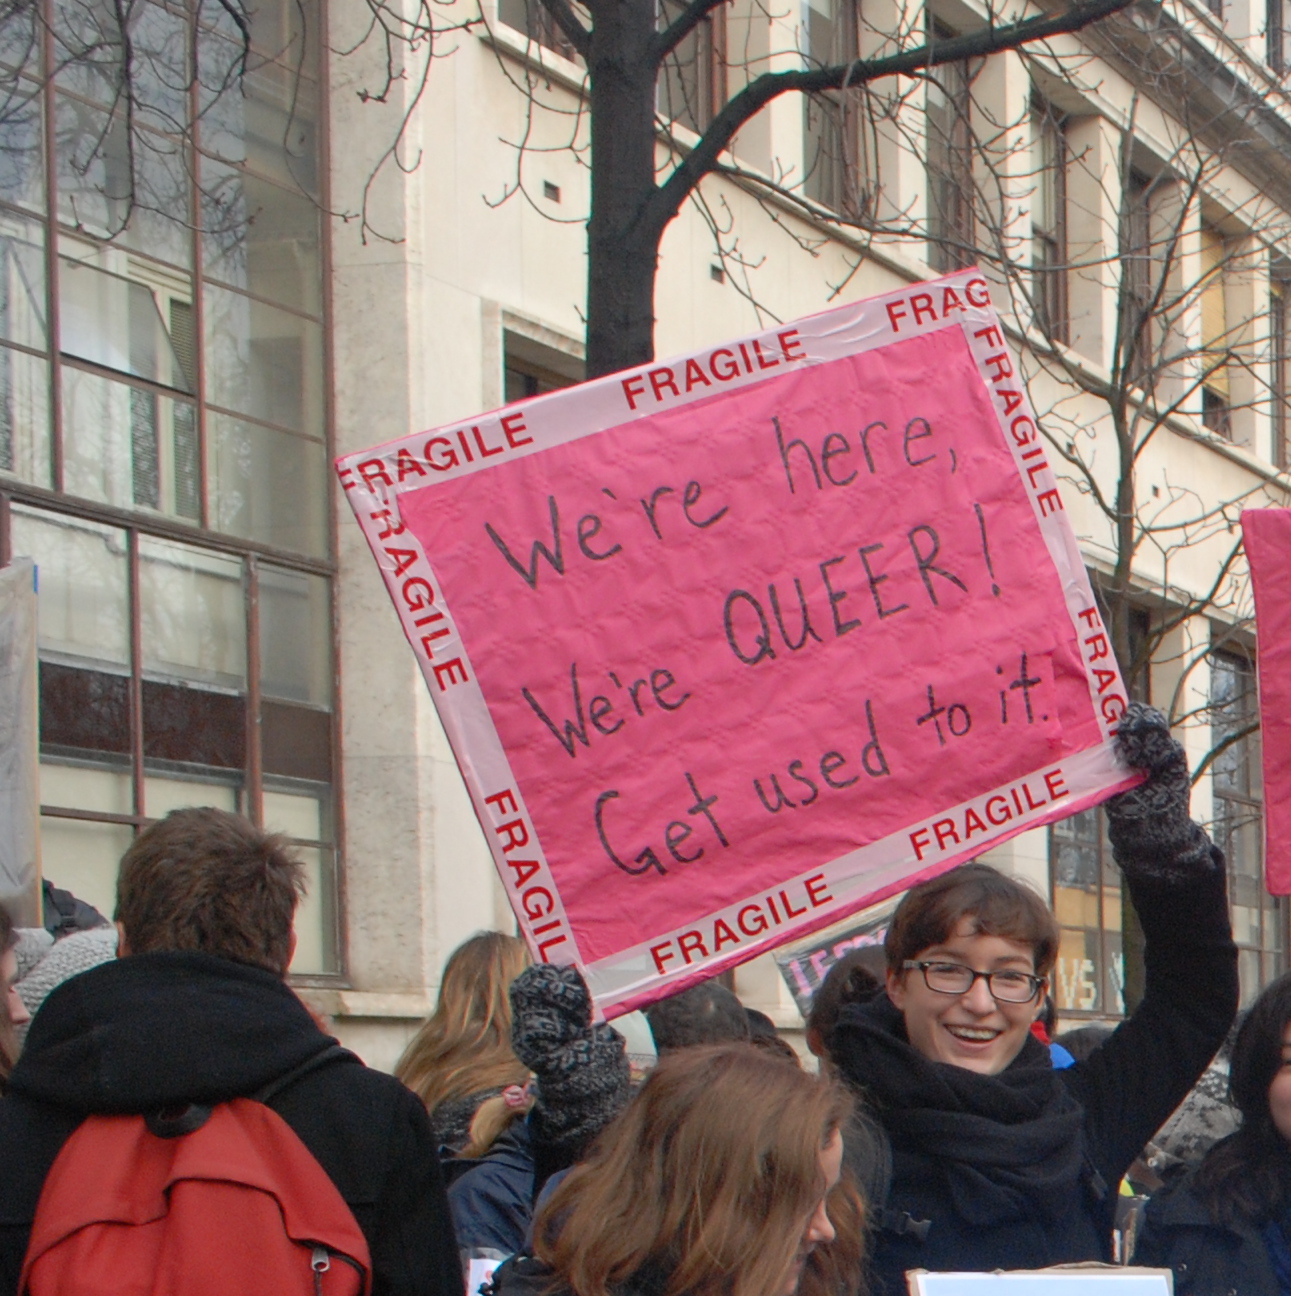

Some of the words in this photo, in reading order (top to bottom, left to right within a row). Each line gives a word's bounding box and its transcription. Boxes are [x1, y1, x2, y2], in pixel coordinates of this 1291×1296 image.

[621, 329, 807, 410] FRAGILE
[484, 476, 729, 591] We're
[772, 413, 960, 496] here,
[974, 324, 1064, 518] FRAGILE
[1078, 606, 1128, 737] FRAG
[370, 499, 470, 692] RAGILE
[484, 788, 578, 968] FRAGIL
[522, 661, 691, 762] We're
[721, 502, 1004, 669] QUEER!
[594, 772, 731, 878] Get
[753, 699, 891, 815] used
[916, 685, 974, 748] to
[649, 872, 834, 976] FRAGILE
[908, 768, 1071, 863] FRAGILE
